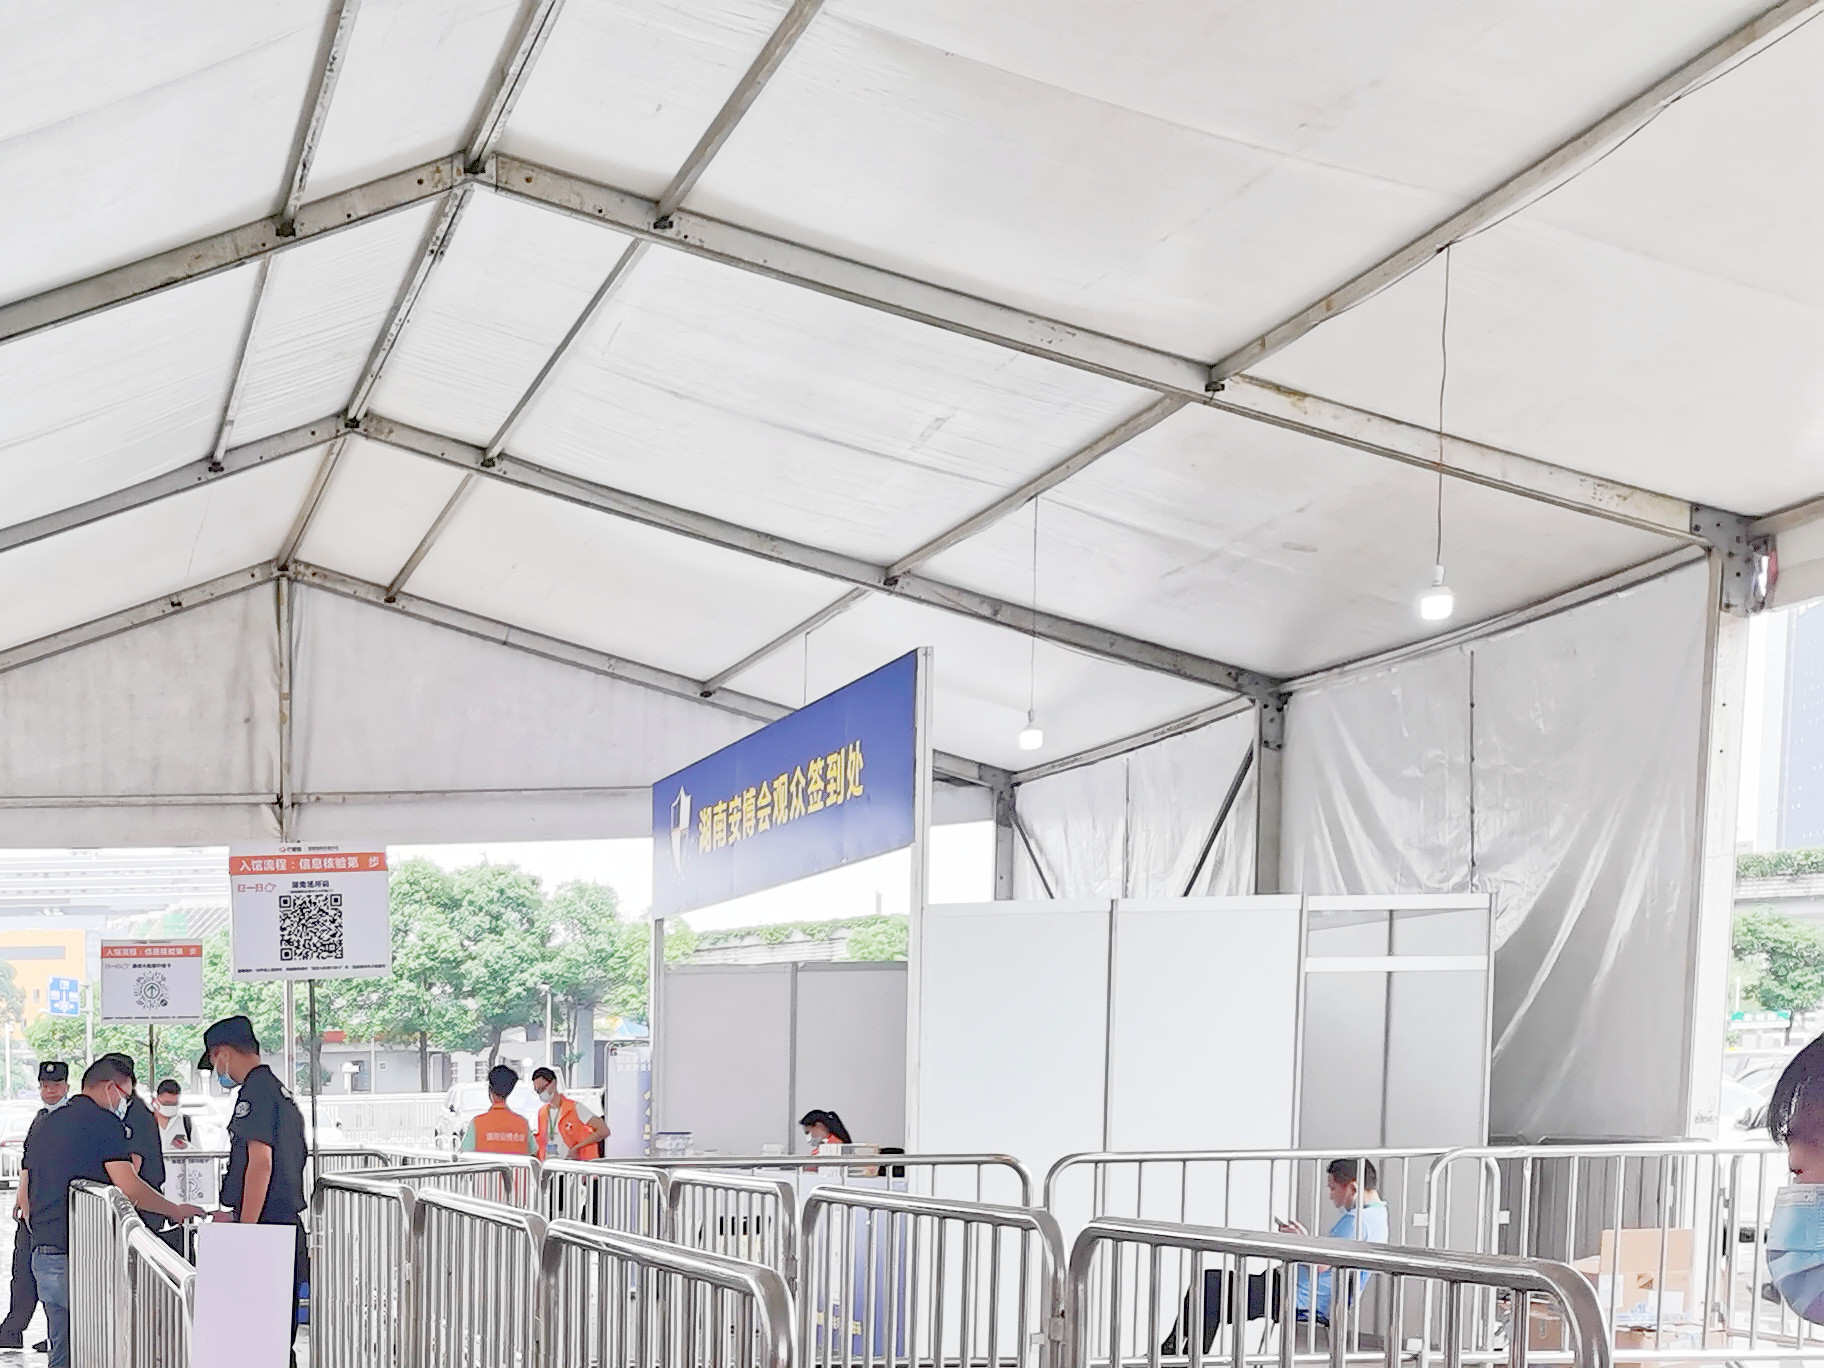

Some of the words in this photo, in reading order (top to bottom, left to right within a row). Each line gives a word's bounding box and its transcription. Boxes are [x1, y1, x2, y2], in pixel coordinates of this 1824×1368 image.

[699, 740, 864, 854] 湖南安博会观众签到处
